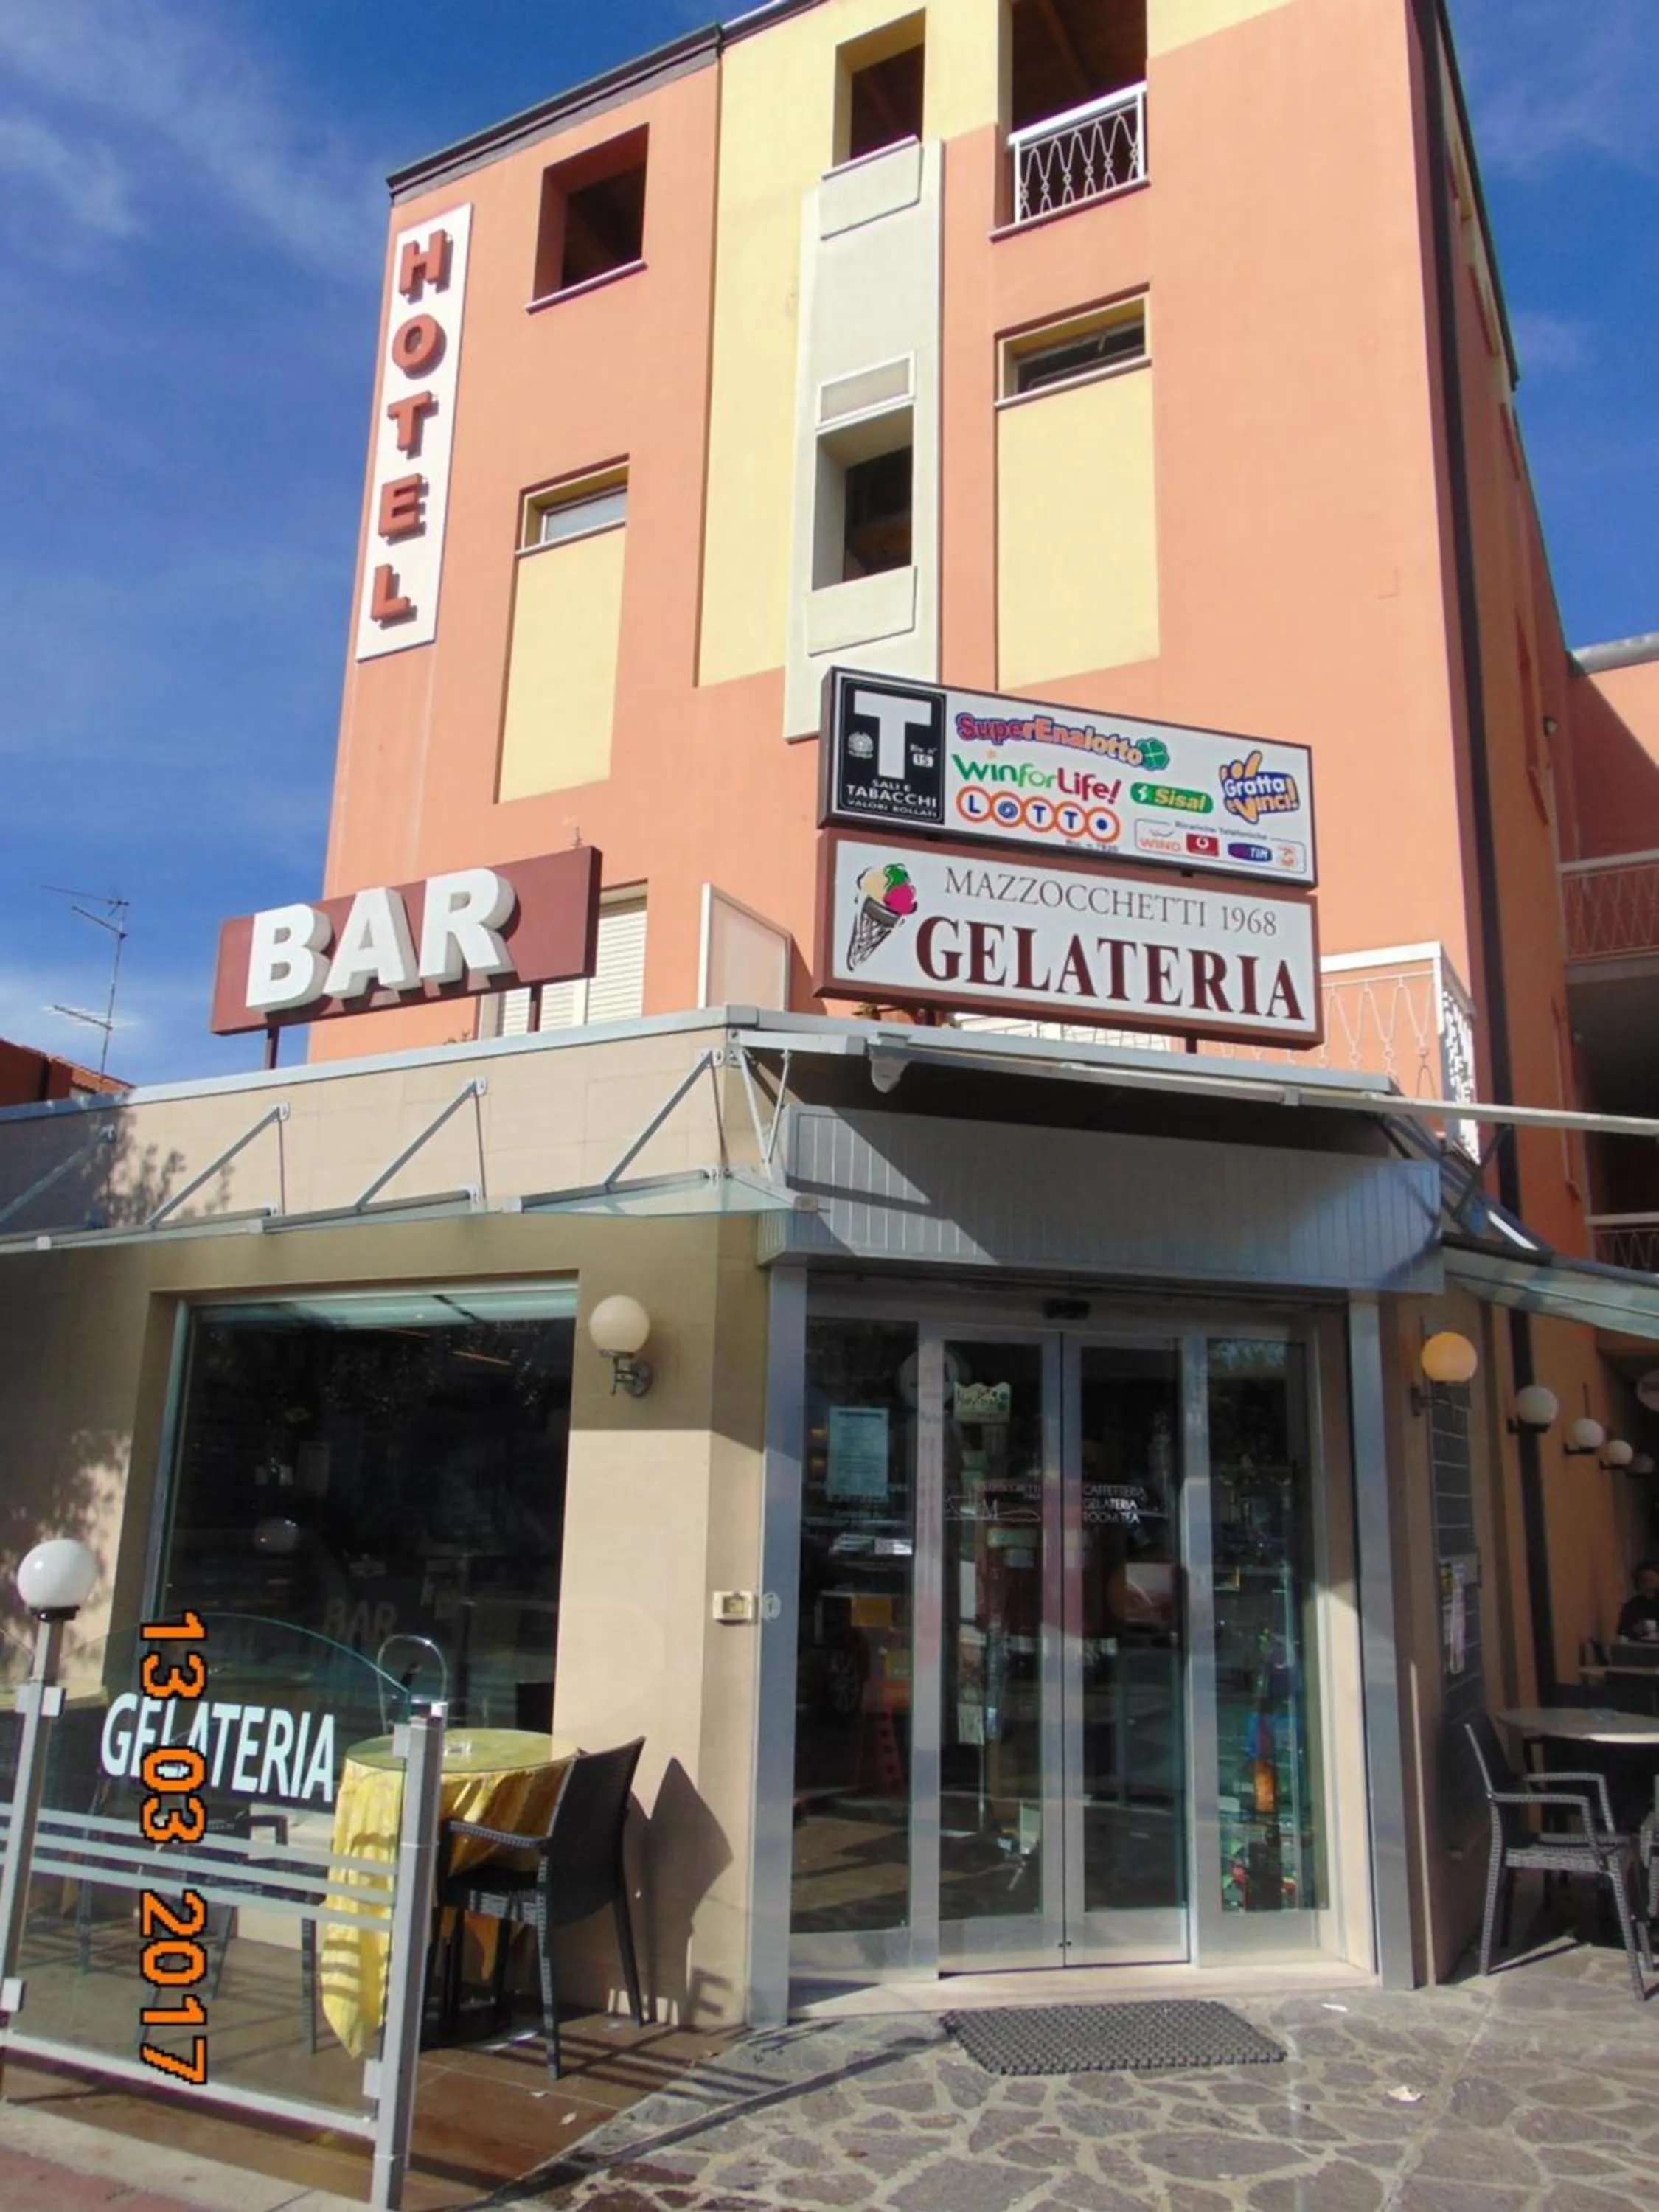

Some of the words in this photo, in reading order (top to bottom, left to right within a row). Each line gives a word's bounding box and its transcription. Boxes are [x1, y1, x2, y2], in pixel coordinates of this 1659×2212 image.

[370, 229, 451, 623] HOTEL
[854, 690, 932, 779] T
[955, 712, 1143, 768] SuperEnalotto
[846, 784, 937, 808] TABACCHI
[848, 799, 888, 811] VALORI
[892, 805, 937, 818] BOLLATI
[872, 779, 900, 791] SALI
[1154, 787, 1207, 812] Sisal
[1224, 775, 1286, 797] Gratta
[962, 790, 1115, 838] LOTTO
[1138, 837, 1181, 852] WIND
[1249, 847, 1268, 860] TIM
[945, 866, 1207, 927] MAZZOCCHETTI
[1221, 905, 1277, 937] 1968
[246, 867, 515, 1012] BAR
[916, 915, 1306, 1021] GELATERIA
[101, 1693, 335, 1803] GELATERIA
